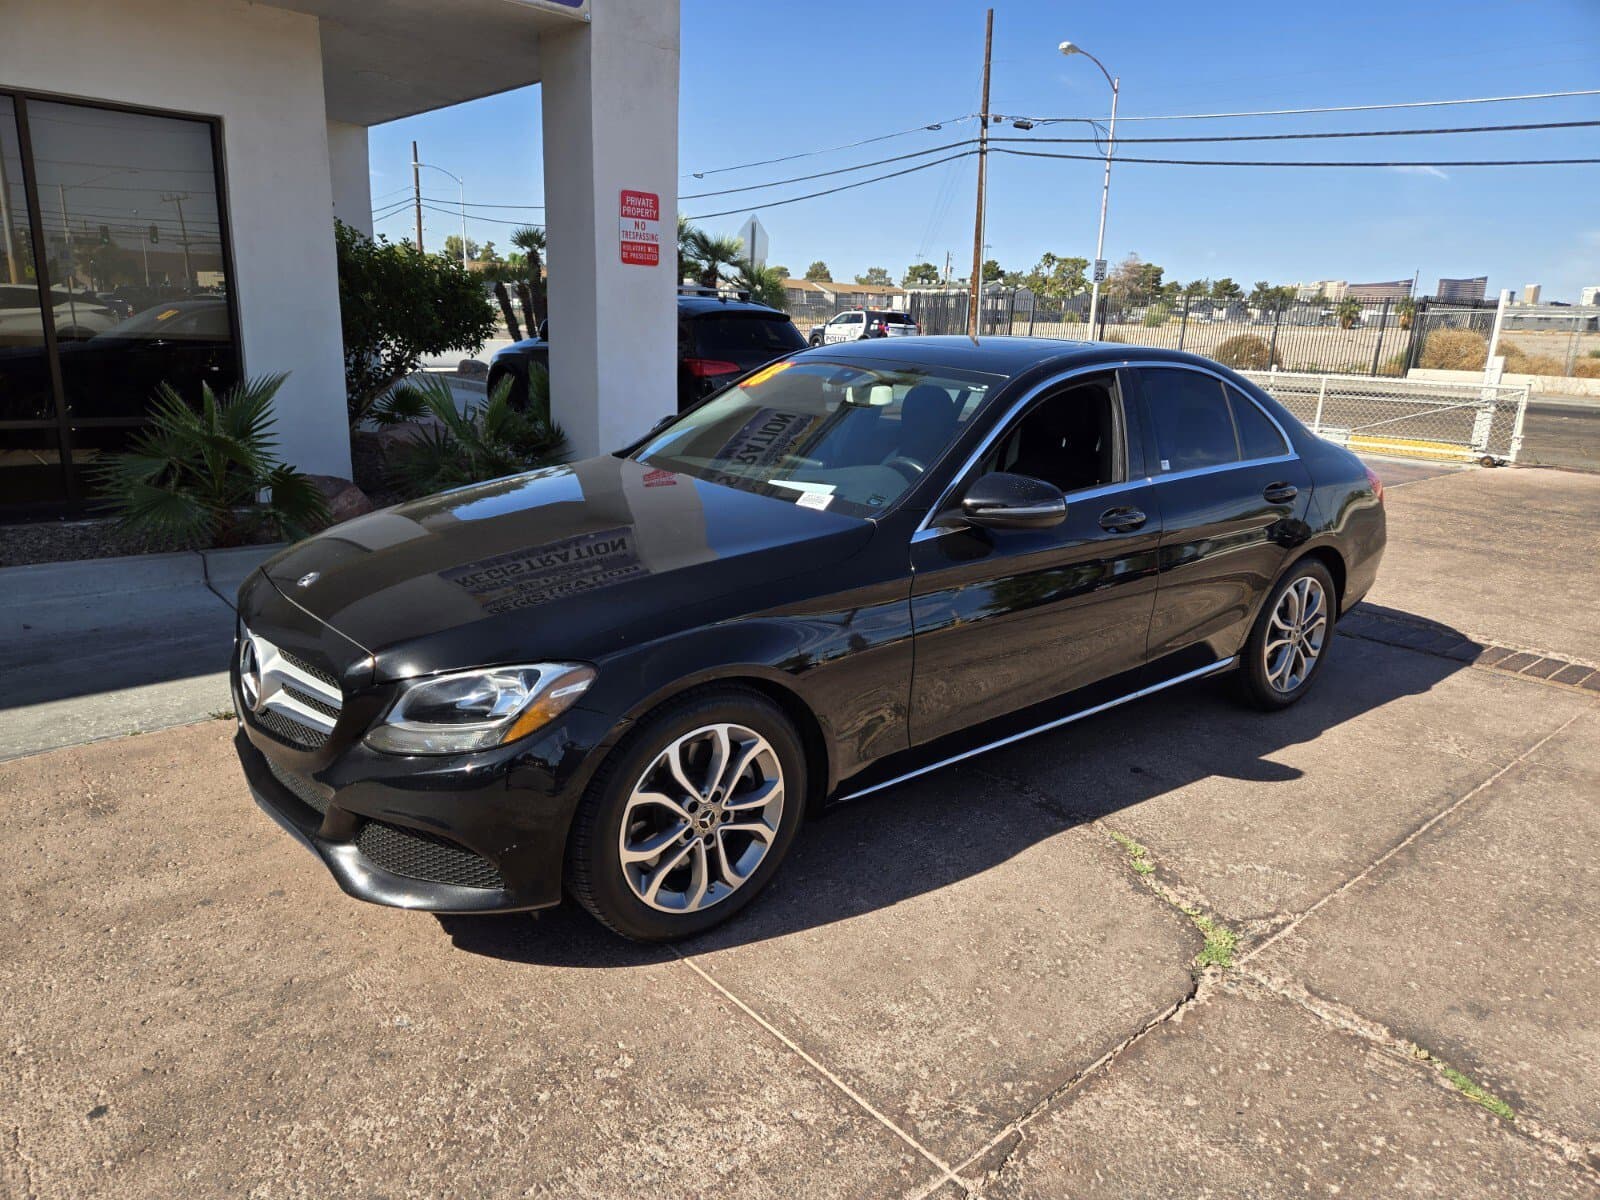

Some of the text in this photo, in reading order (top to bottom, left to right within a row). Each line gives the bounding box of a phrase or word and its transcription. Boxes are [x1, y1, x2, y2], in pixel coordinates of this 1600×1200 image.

[626, 195, 654, 208] PRIVATE
[622, 206, 657, 218] PROPERTY
[634, 220, 646, 231] NO
[621, 230, 659, 242] TRESPASSING
